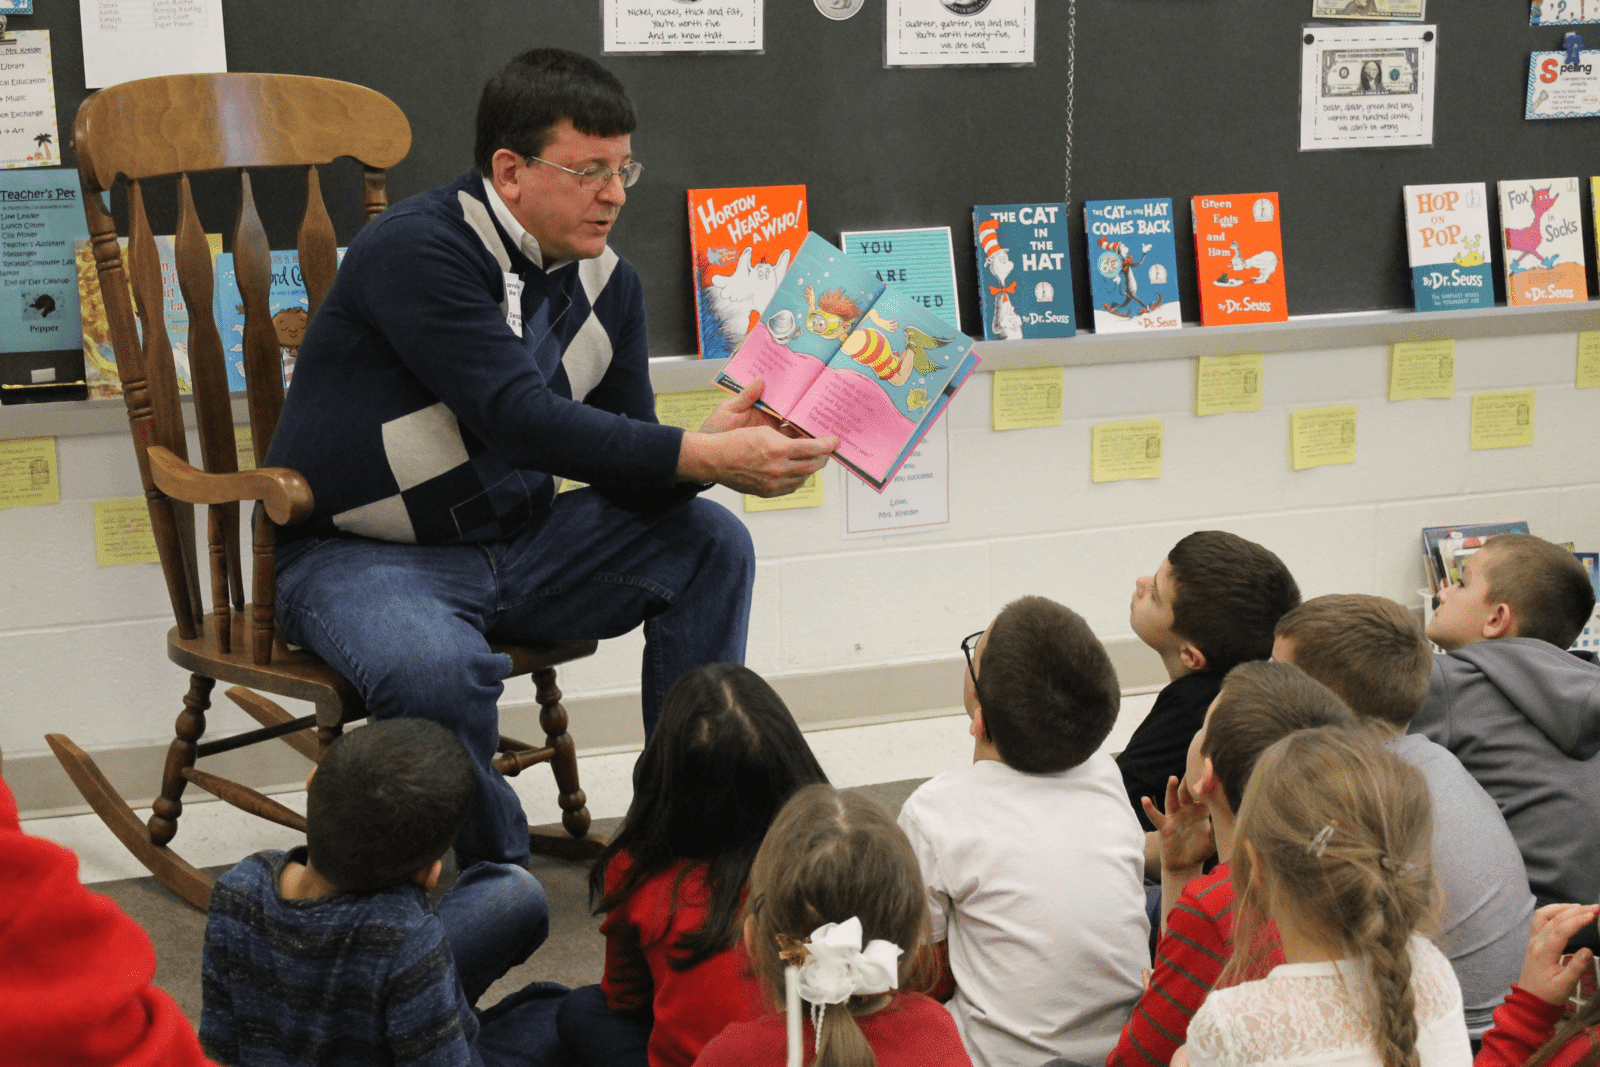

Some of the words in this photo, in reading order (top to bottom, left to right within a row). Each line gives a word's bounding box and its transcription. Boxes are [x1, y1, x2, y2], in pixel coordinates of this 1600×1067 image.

[684, 7, 705, 16] thick
[707, 7, 723, 16] and
[726, 8, 743, 17] fat,
[651, 20, 676, 28] You're
[678, 19, 702, 27] worth
[974, 20, 986, 30] big
[988, 19, 1002, 28] and
[648, 31, 665, 40] And
[915, 31, 937, 40] You're
[12, 78, 46, 86] Education
[1366, 103, 1385, 113] green
[1386, 102, 1399, 110] and
[10, 110, 44, 118] Exchange
[1362, 112, 1389, 120] hundred
[0, 189, 53, 202] Teacher's
[55, 188, 76, 200] Pet
[1201, 198, 1232, 209] Green
[1416, 190, 1460, 214] HOP
[16, 212, 40, 220] Leader
[696, 194, 756, 234] HORTON
[990, 211, 1016, 224] THE
[1018, 206, 1058, 225] CAT
[1104, 205, 1126, 220] CAT
[1144, 202, 1169, 217] HAT
[726, 205, 770, 244] HEARS
[752, 232, 762, 244] A
[760, 199, 804, 242] WHO!
[1212, 213, 1239, 228] Eggs
[1430, 215, 1445, 225] ON
[1034, 227, 1048, 238] IN
[1092, 220, 1135, 236] COMES
[1136, 219, 1172, 235] BACK
[1545, 218, 1578, 243] Socks
[1206, 231, 1226, 242] and
[1419, 224, 1461, 248] POP
[860, 240, 892, 254] YOU
[1029, 241, 1054, 250] THE
[1208, 247, 1231, 257] Ham
[1022, 252, 1065, 271] HAT
[875, 268, 908, 282] ARE
[1430, 272, 1450, 289] Dr.
[1452, 268, 1483, 288] Seuss
[1548, 284, 1574, 300] Seuss
[1225, 298, 1242, 314] Dr.
[1242, 296, 1272, 312] Seuss
[1029, 312, 1044, 325] Dr.
[1044, 310, 1070, 324] Seuss
[1144, 318, 1156, 328] Dr.
[1157, 317, 1178, 327] Seuss
[30, 325, 58, 333] Pepper
